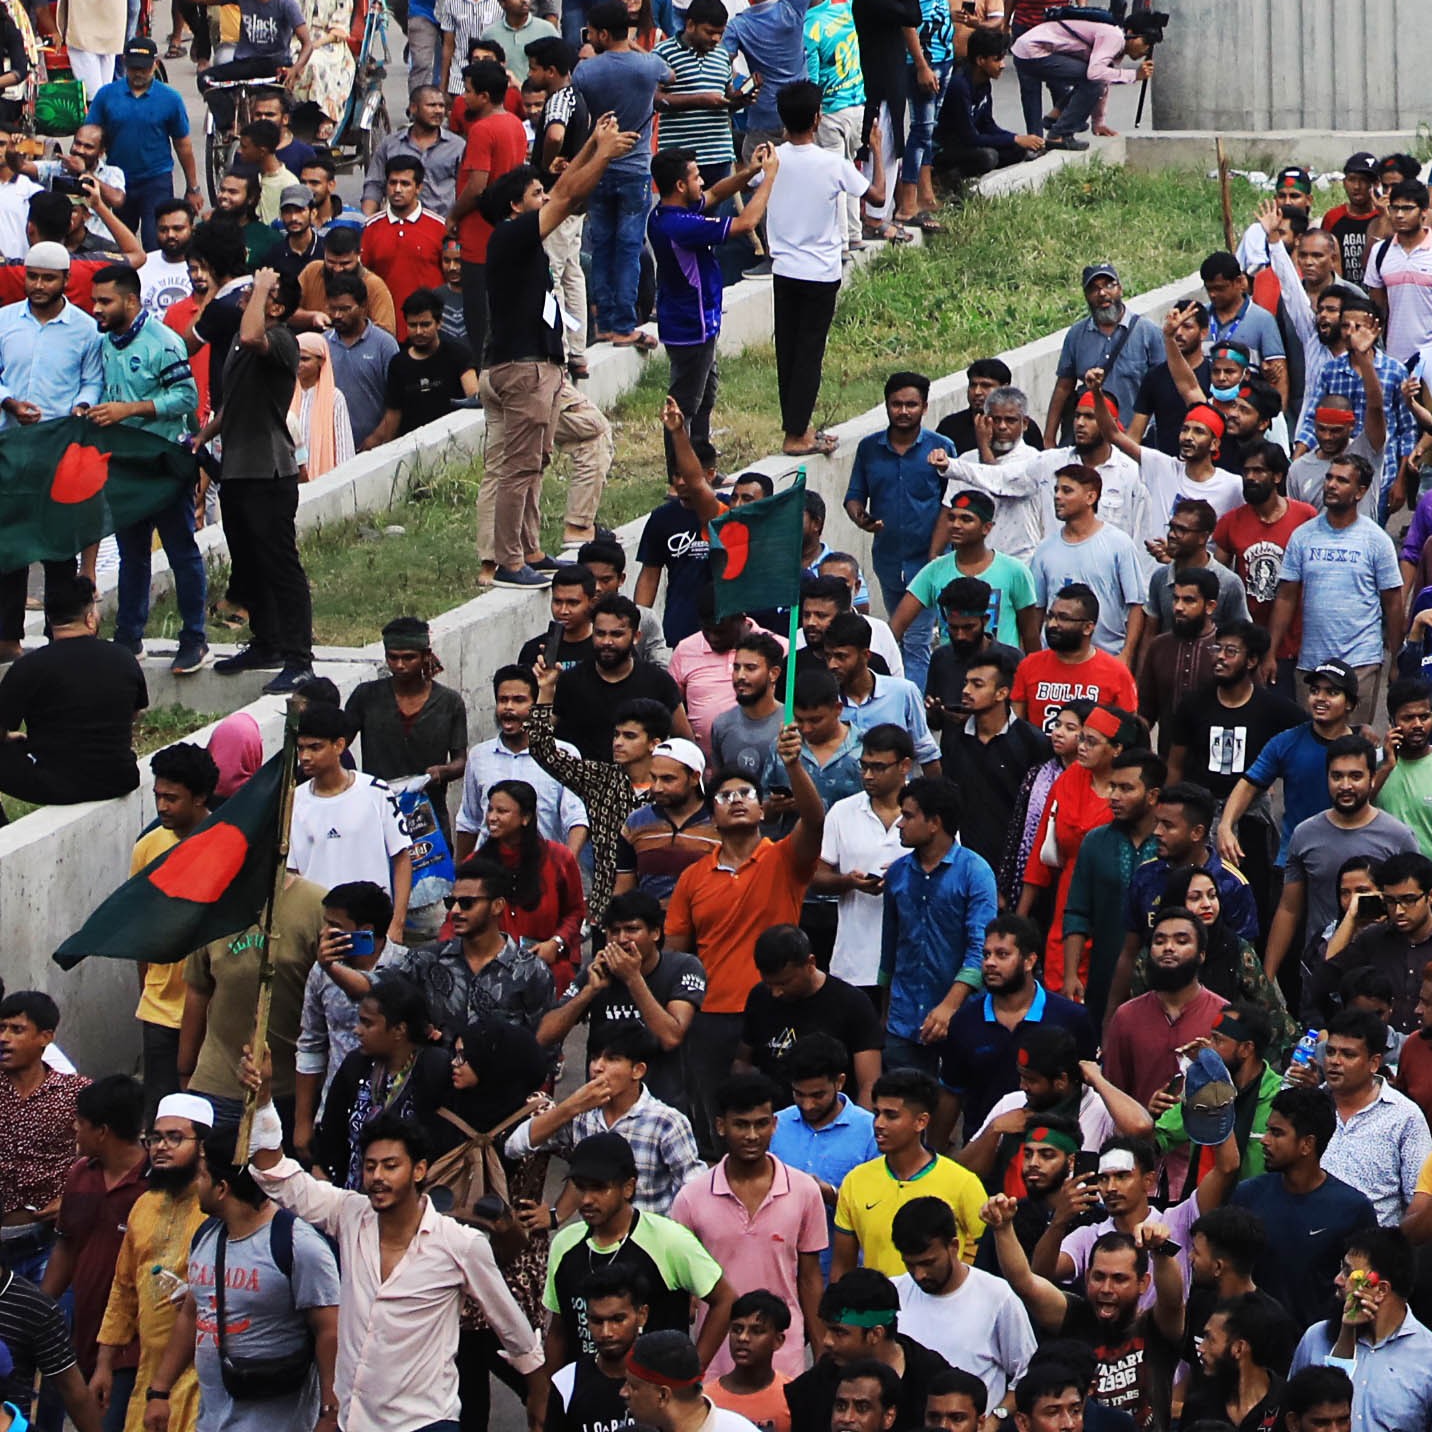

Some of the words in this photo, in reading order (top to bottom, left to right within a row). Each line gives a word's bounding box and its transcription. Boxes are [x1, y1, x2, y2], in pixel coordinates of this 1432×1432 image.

[1309, 548, 1361, 563] NEXT
[1036, 681, 1099, 703] BULLS
[189, 1261, 260, 1292] CAADA
[1098, 1367, 1136, 1394] 1996
